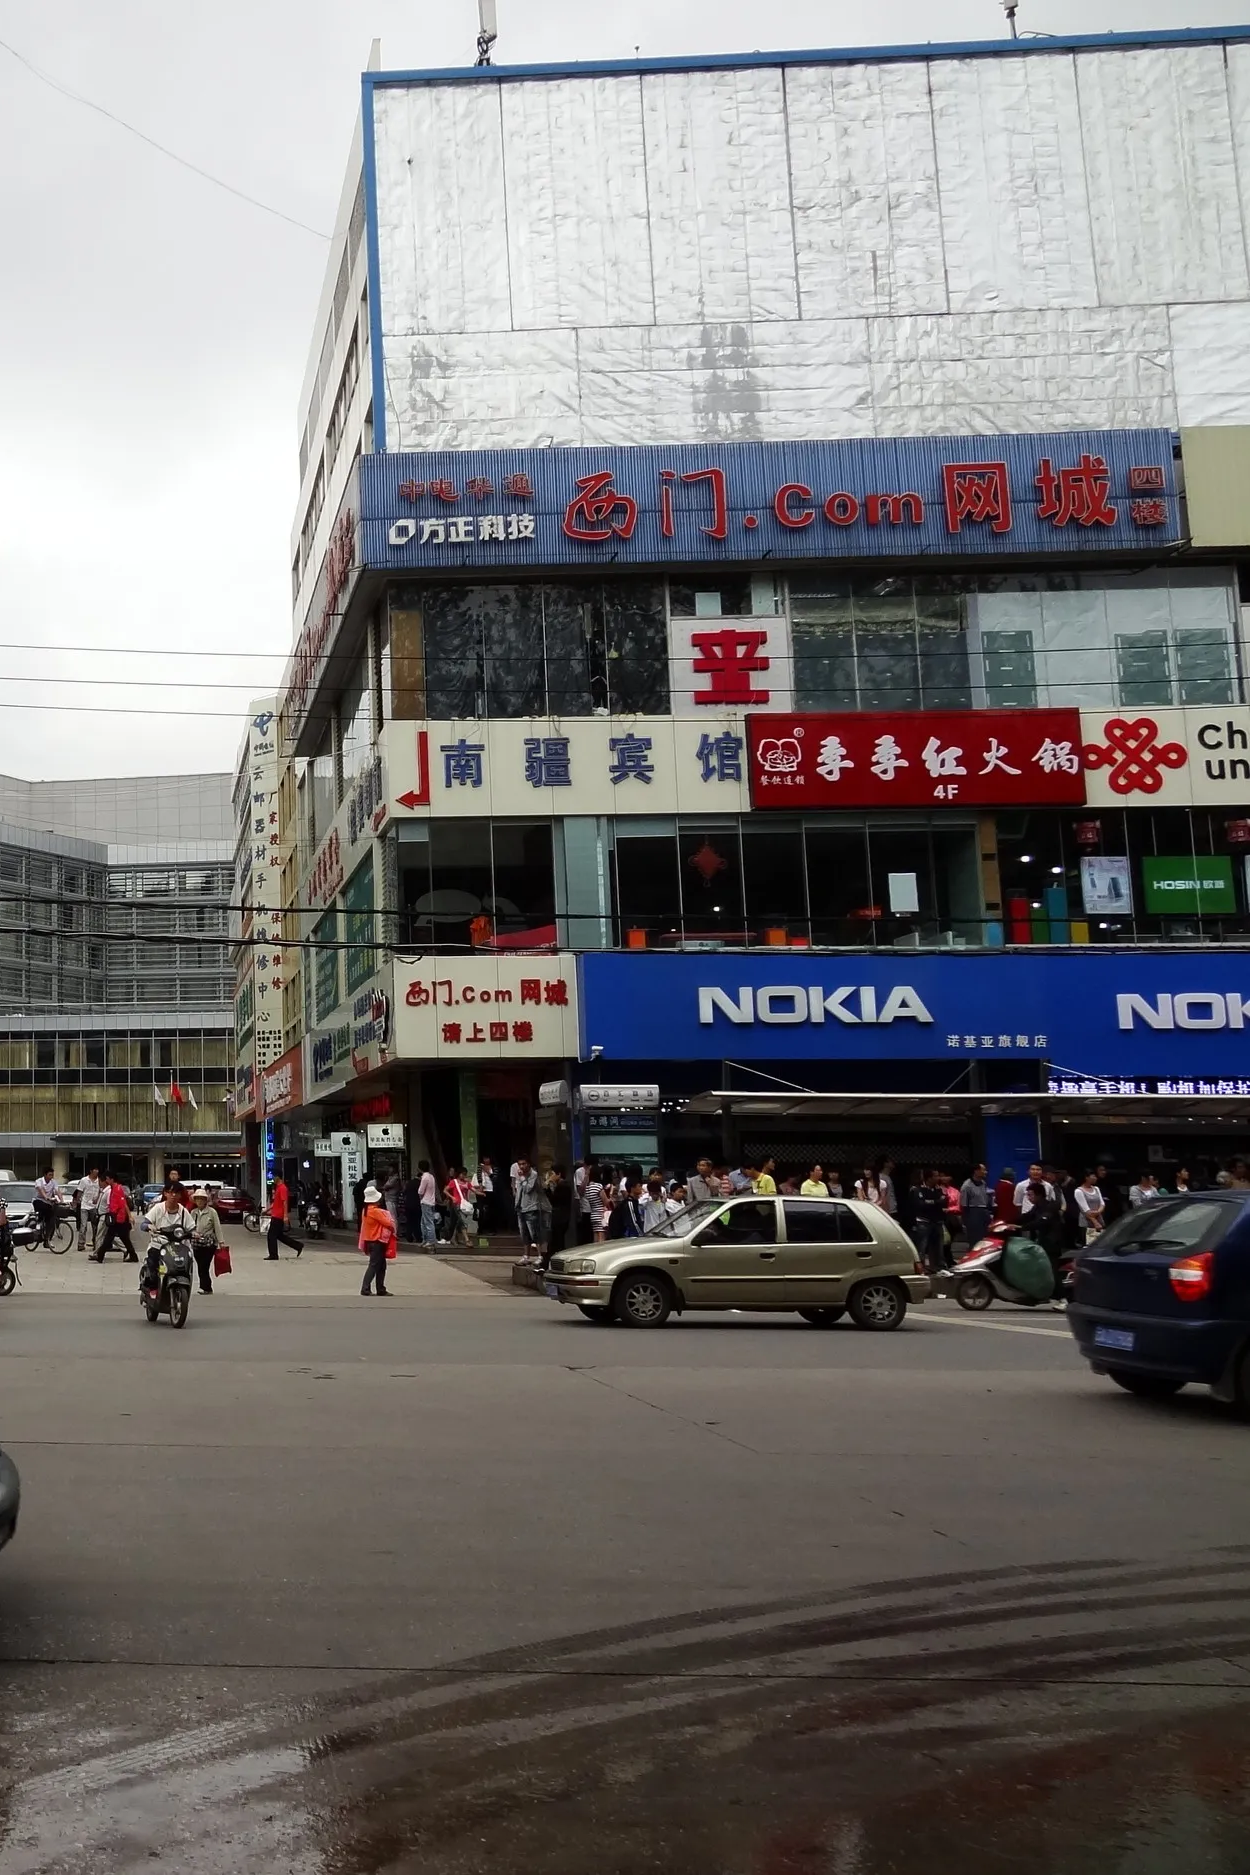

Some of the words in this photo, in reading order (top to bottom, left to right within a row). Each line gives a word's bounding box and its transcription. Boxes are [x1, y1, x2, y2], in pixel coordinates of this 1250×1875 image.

[399, 473, 535, 503] 中电华通
[419, 513, 536, 545] 方正科技
[440, 731, 743, 789] 南疆宾馆
[816, 734, 1080, 782] 季季红火锅
[934, 784, 959, 800] 4F
[1153, 879, 1200, 890] HOSIN
[698, 986, 935, 1024] NOKIA
[442, 1021, 533, 1043] 请上四楼
[946, 1034, 1048, 1048] 诺基亚旗舰店
